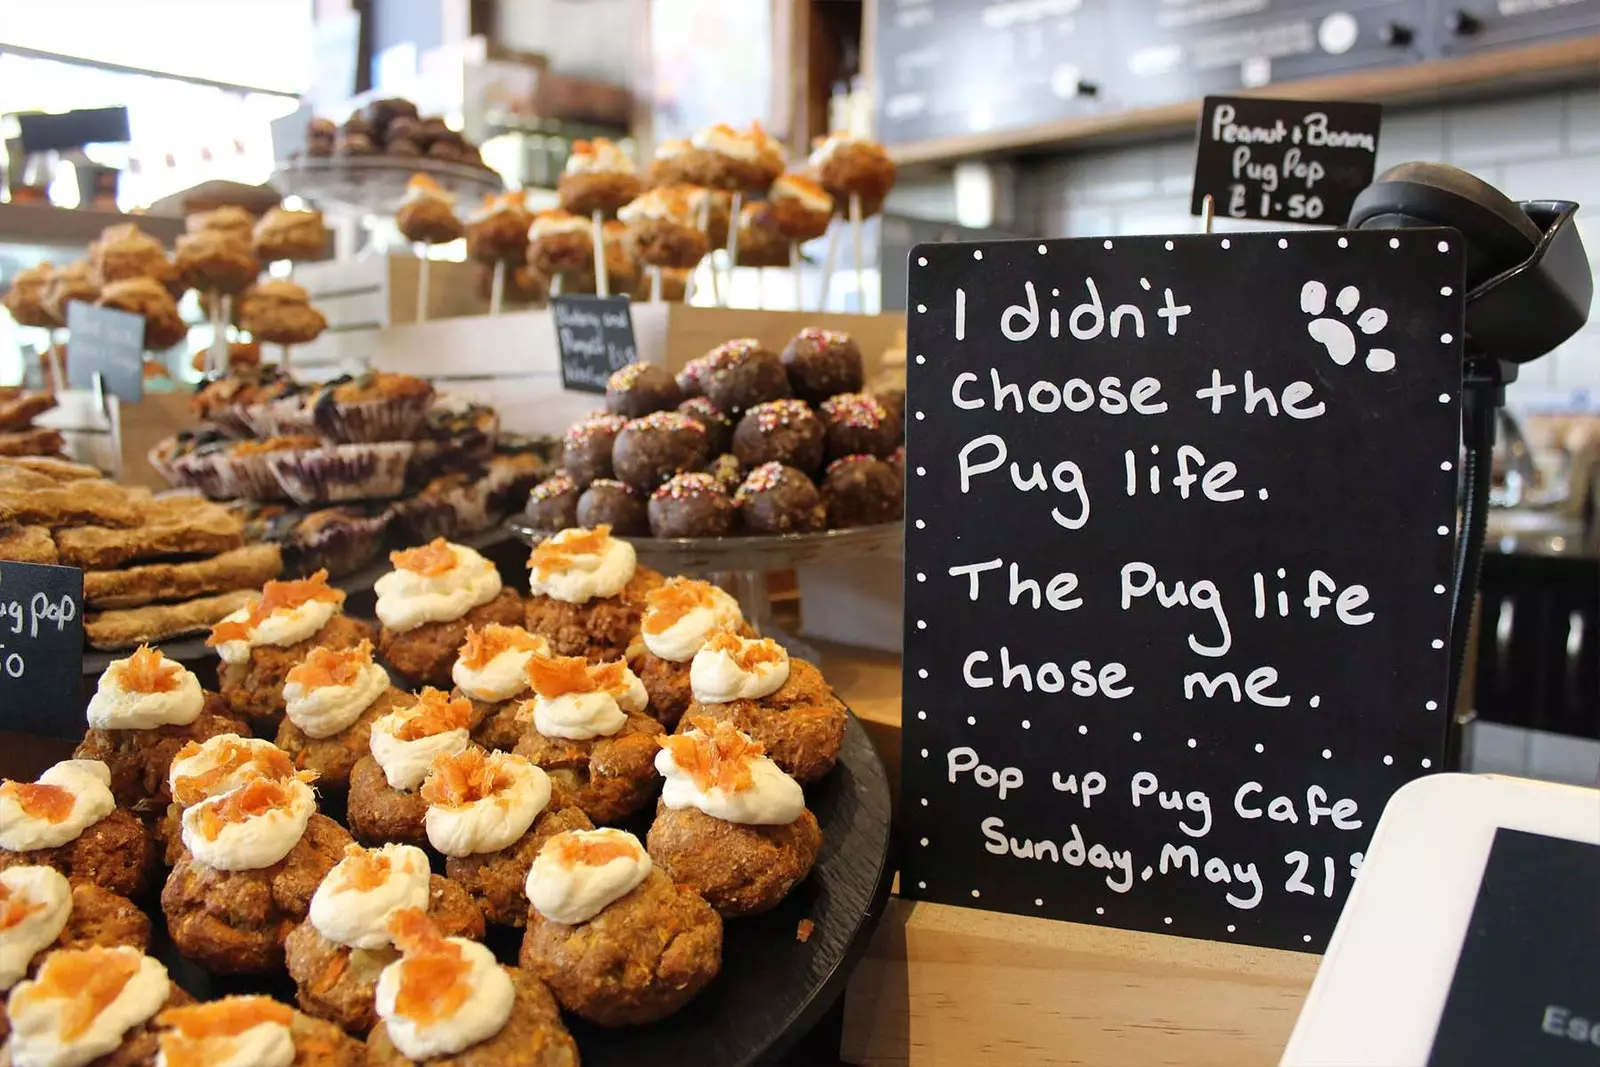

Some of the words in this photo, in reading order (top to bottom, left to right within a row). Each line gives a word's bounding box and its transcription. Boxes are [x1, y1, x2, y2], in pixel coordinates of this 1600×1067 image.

[1212, 104, 1288, 144] Peanut
[1232, 145, 1279, 192] Pug
[1282, 147, 1325, 189] Pop
[955, 288, 966, 341] I
[1000, 276, 1192, 342] didn't
[1195, 368, 1326, 420] the
[957, 434, 1090, 530] Pug
[1124, 444, 1270, 502] life.
[948, 557, 1084, 611] The
[1120, 561, 1232, 658] Pug
[1253, 567, 1375, 626] life
[1183, 666, 1321, 708] me.
[947, 746, 1024, 800] Pop
[1052, 771, 1107, 809] up
[1131, 771, 1212, 838] Pug
[1233, 781, 1363, 830] Cafe
